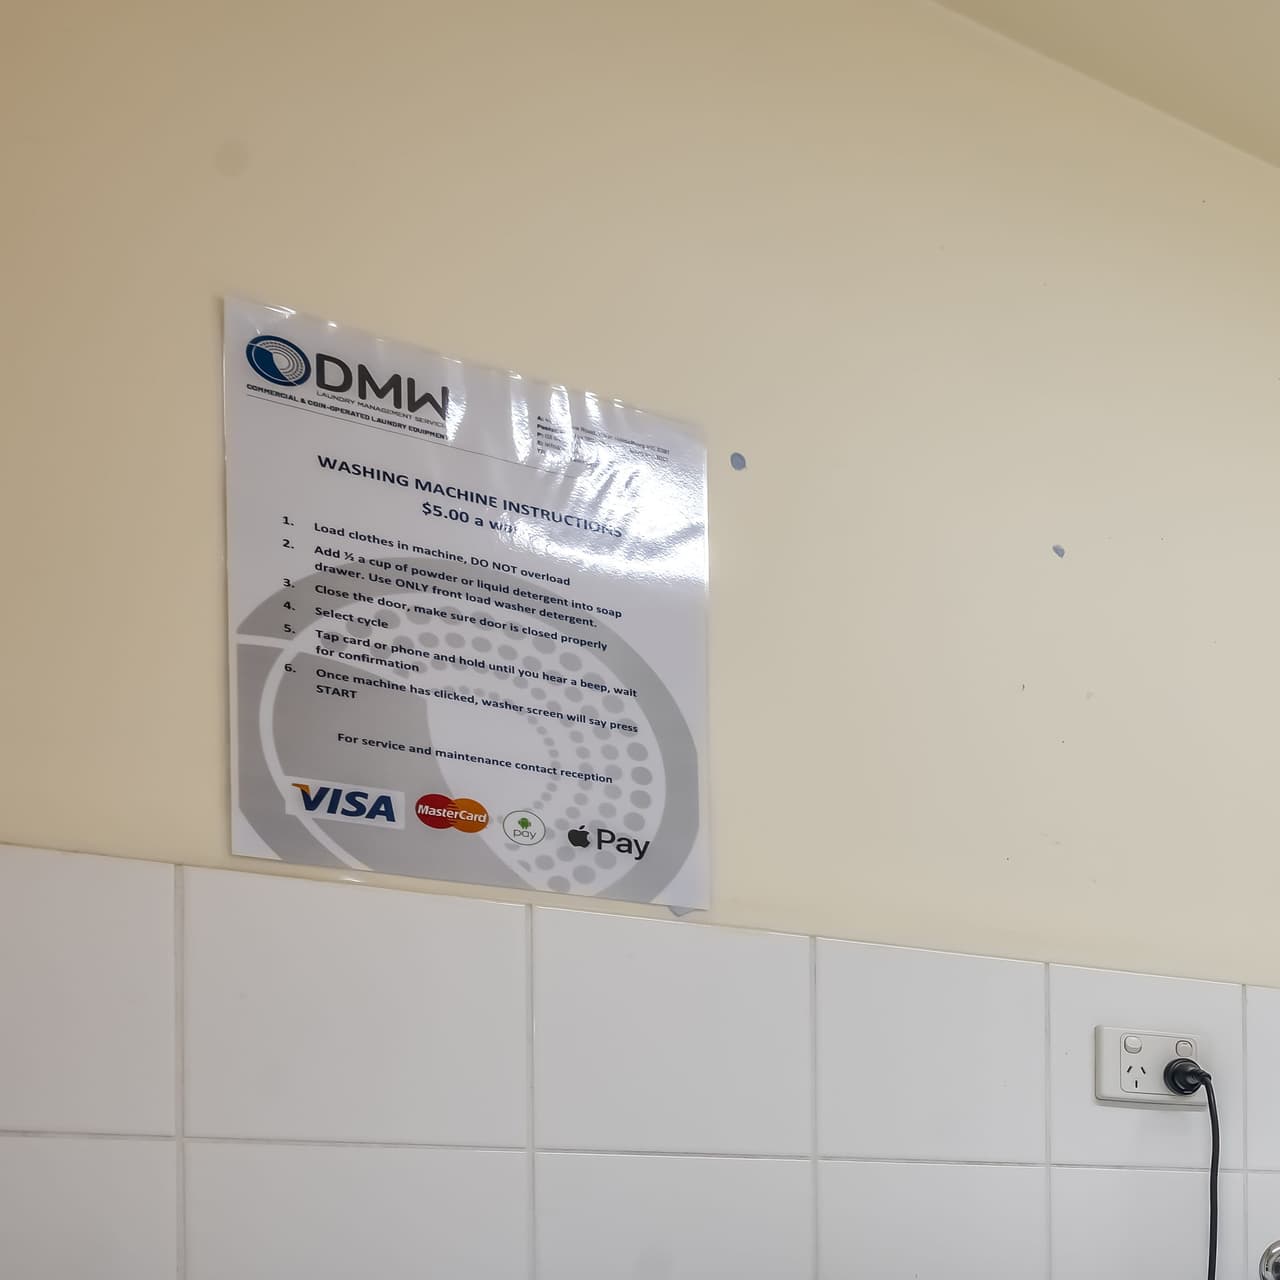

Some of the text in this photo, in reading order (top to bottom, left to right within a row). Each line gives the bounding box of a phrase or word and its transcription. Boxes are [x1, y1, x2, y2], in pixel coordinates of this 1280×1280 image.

[247, 384, 297, 402] COMMERCIAL
[308, 400, 369, 420] COIN-OPERATED
[371, 416, 406, 429] LAUNDRY
[316, 353, 450, 421] DMW
[317, 455, 409, 487] WASHING
[415, 478, 497, 508] MACHINE
[503, 499, 623, 538] INSTRUCTIONS
[422, 501, 483, 527] $5.00 a
[283, 516, 570, 586] 1. Load clothes in machine, DO NOT overload
[283, 539, 294, 549] 2.
[314, 546, 340, 559] Add
[358, 556, 366, 564] a
[369, 558, 392, 571] cup
[395, 562, 408, 573] of
[411, 567, 458, 582] powder
[462, 578, 474, 586] or
[477, 579, 509, 594] liquid
[513, 587, 568, 607] detergent
[572, 600, 593, 613] into
[596, 607, 622, 619] soap
[283, 578, 608, 651] 3. Close the door, make sure door is closed properly
[283, 601, 389, 629] 4. Select cycle
[315, 562, 598, 628] drawer. Use ONLY front load washer detergent.
[284, 624, 638, 698] 5. Tap card or phone and hold until you hear a beep, wait
[315, 645, 420, 672] for confirmation
[316, 685, 358, 699] START
[284, 663, 639, 733] 6. Once machine has clicked, washer screen will say press
[337, 733, 613, 784] For service and maintenance contact reception
[291, 783, 651, 861] VISA MasterCard pay Pay
